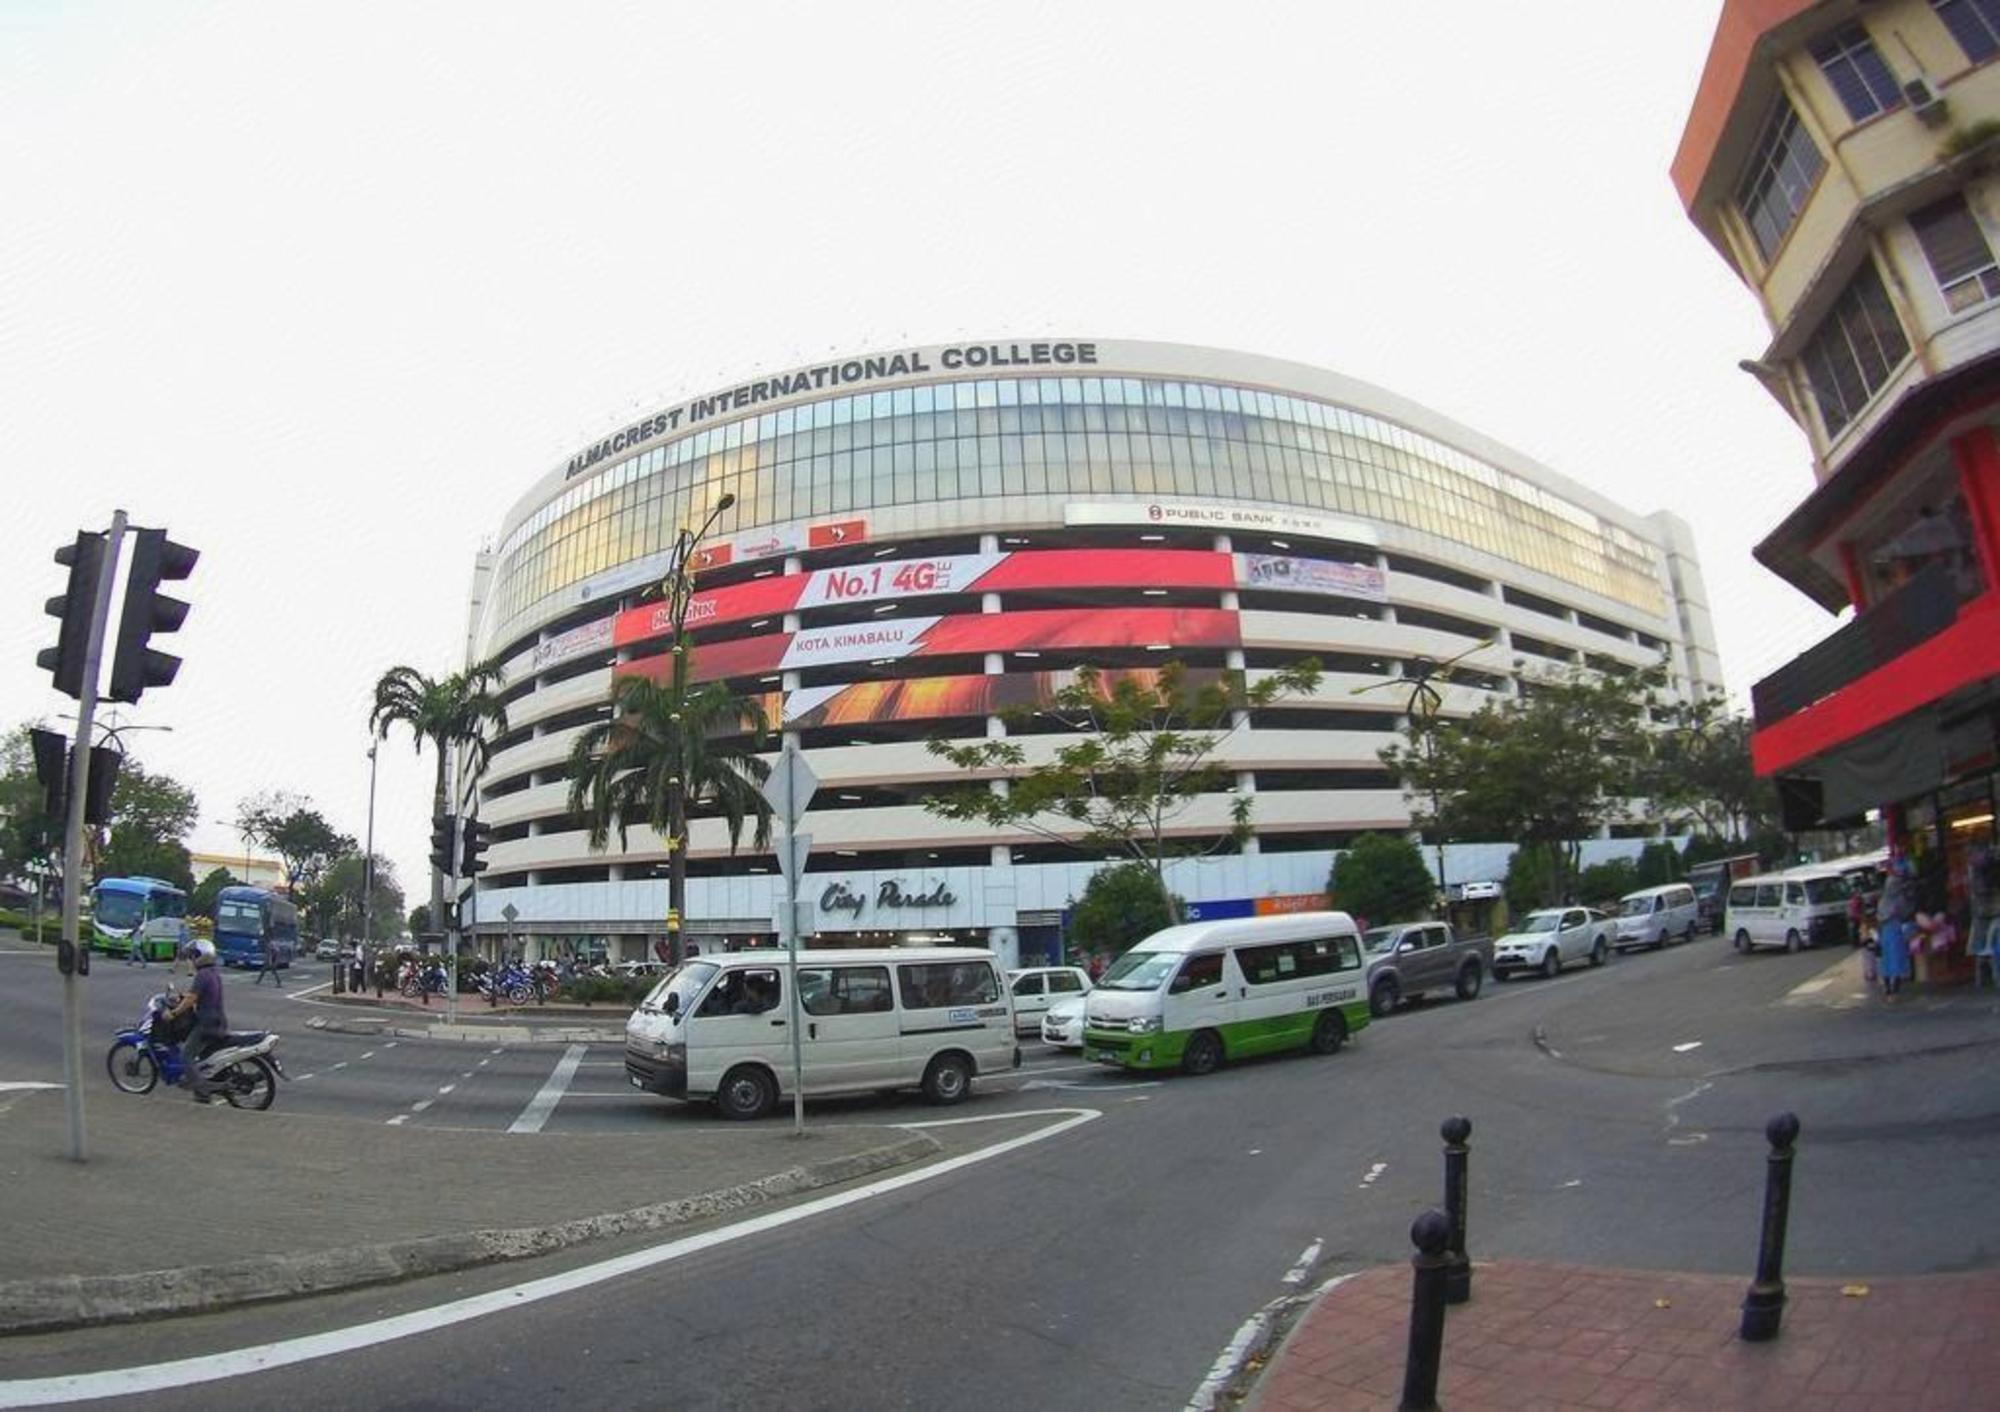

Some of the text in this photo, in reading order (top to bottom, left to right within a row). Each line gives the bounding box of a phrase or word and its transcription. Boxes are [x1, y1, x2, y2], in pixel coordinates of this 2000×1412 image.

[565, 343, 1097, 481] ALMACREST INTERNATIONAL COLLEGE
[1166, 508, 1225, 521] PUBLIC
[1231, 512, 1275, 524] BANK
[825, 561, 936, 599] No.1 4G
[796, 630, 903, 651] KOTA KINABALU
[820, 880, 957, 920] City Parade
